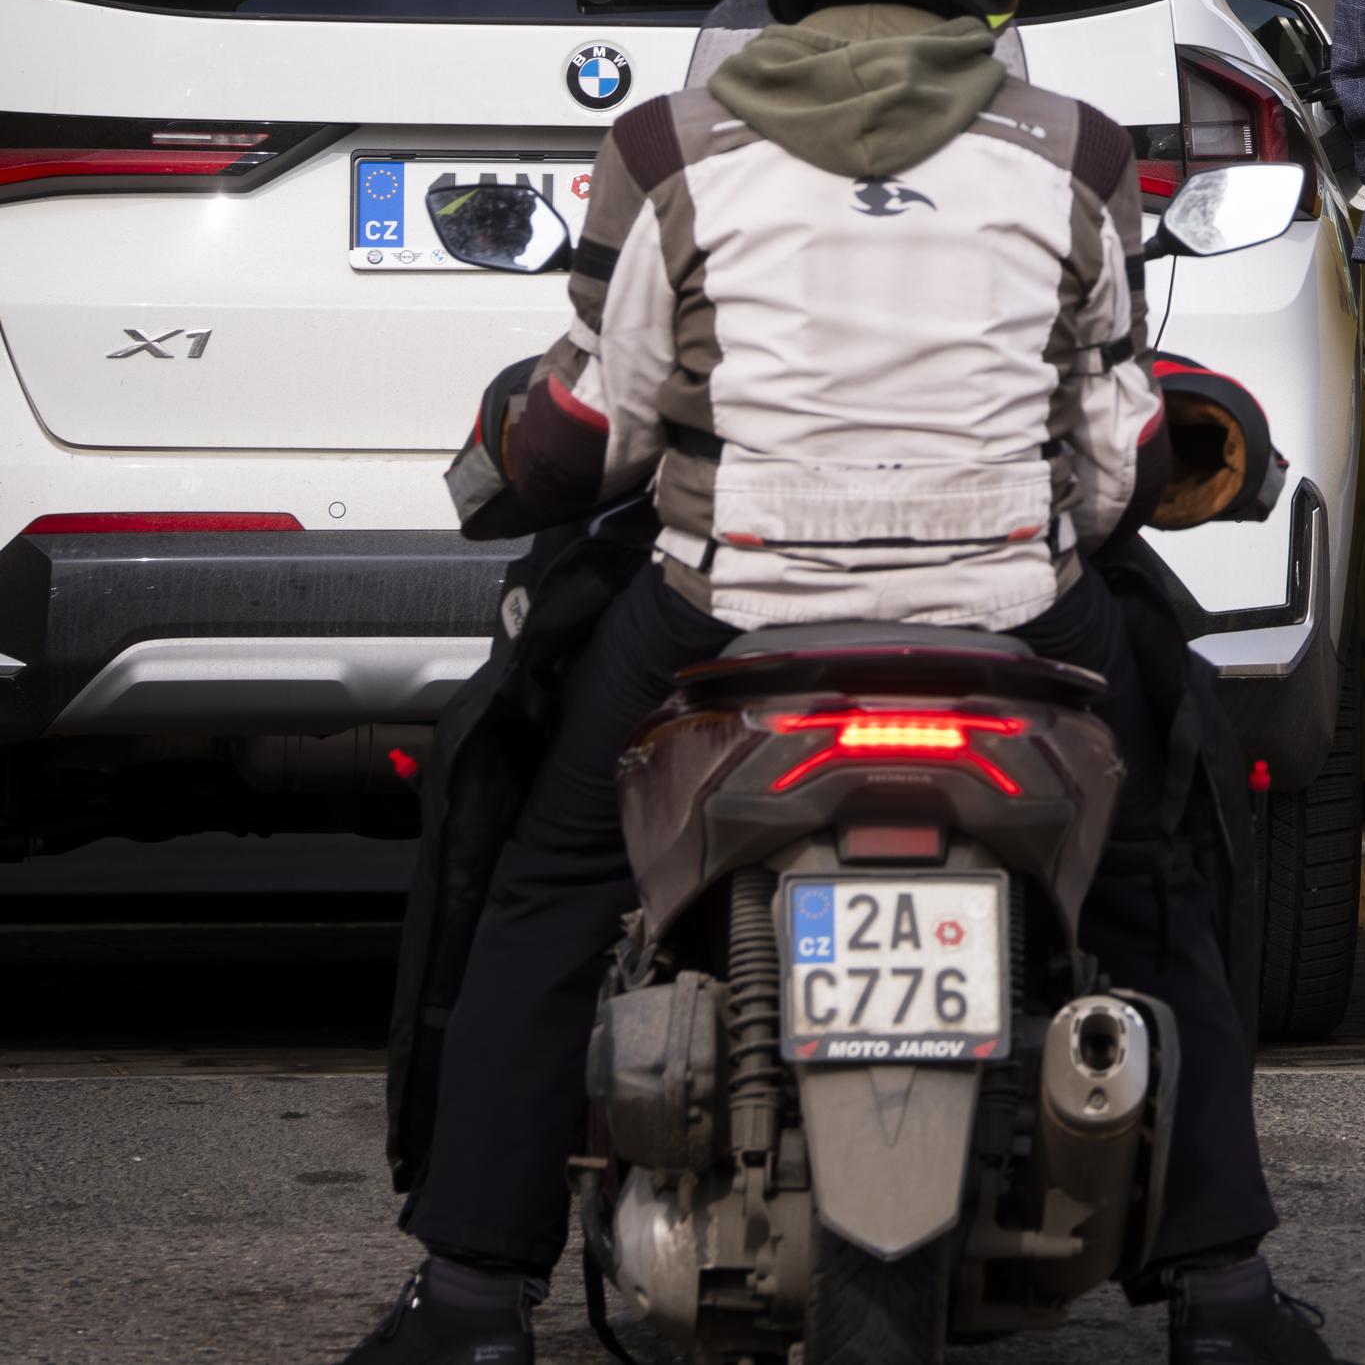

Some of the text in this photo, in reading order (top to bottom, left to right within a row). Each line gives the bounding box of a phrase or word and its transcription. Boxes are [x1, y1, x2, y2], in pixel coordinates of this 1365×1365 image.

[572, 46, 628, 68] BMW
[365, 220, 399, 241] CZ
[105, 328, 213, 359] X1
[847, 892, 922, 951] 2A
[799, 936, 831, 957] CZ
[803, 968, 968, 1026] C776
[827, 1040, 966, 1058] MOTO JAROV
